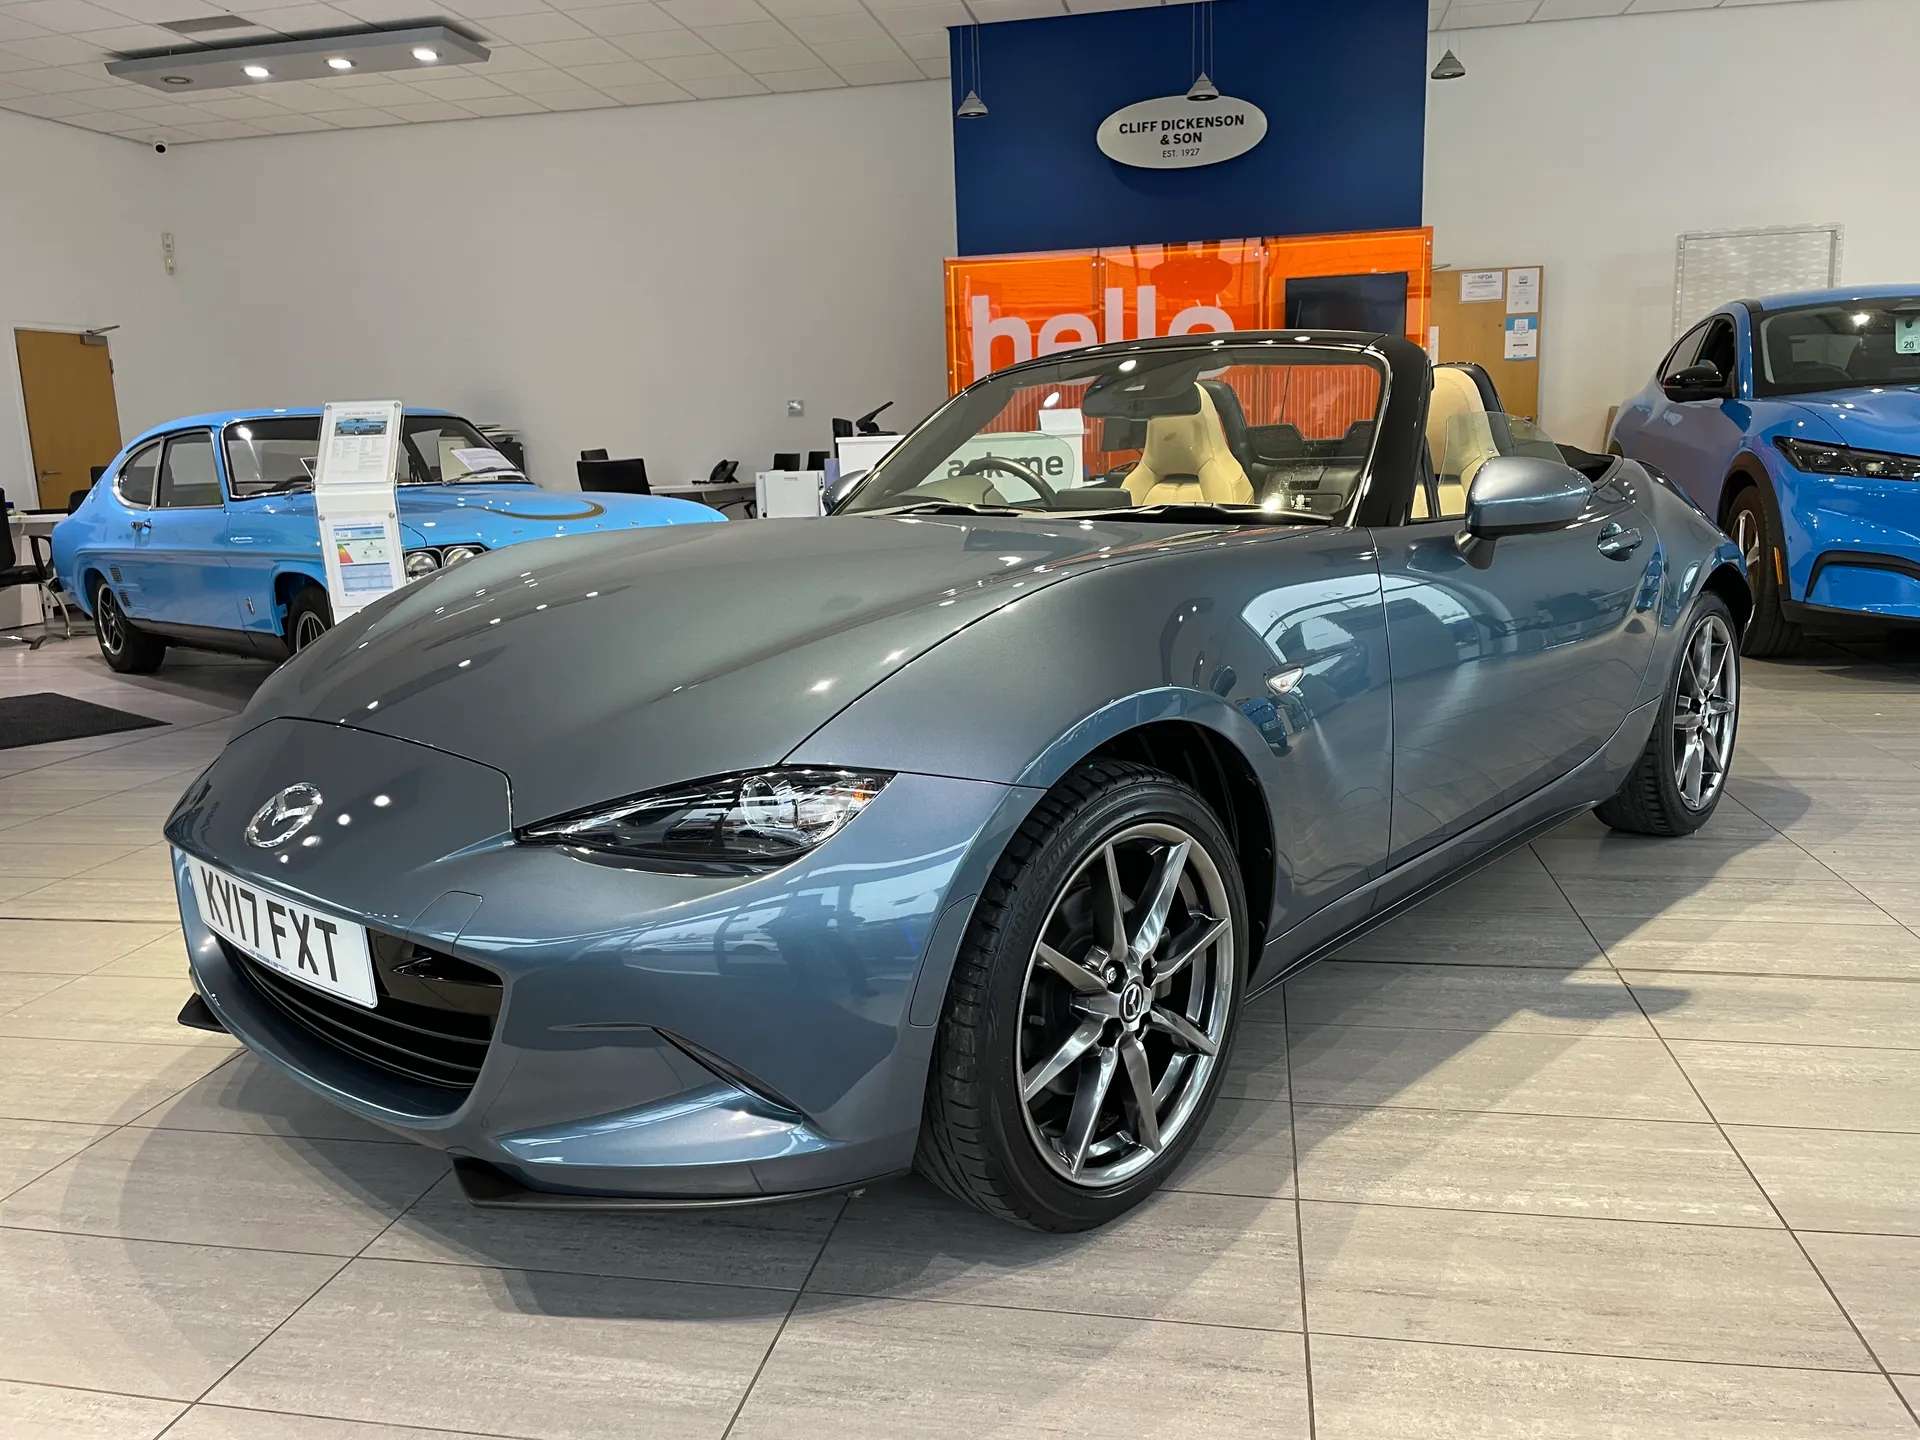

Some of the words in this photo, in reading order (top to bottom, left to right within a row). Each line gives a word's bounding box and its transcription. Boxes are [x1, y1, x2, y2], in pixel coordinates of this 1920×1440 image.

[1119, 120, 1158, 134] CLIFF
[1161, 114, 1245, 131] DICKENSON
[1160, 134, 1170, 145] &
[1173, 132, 1203, 144] SON
[1162, 149, 1178, 158] EST.
[1182, 148, 1200, 157] 1927
[200, 865, 260, 949] KY17
[266, 899, 338, 983] FXT
